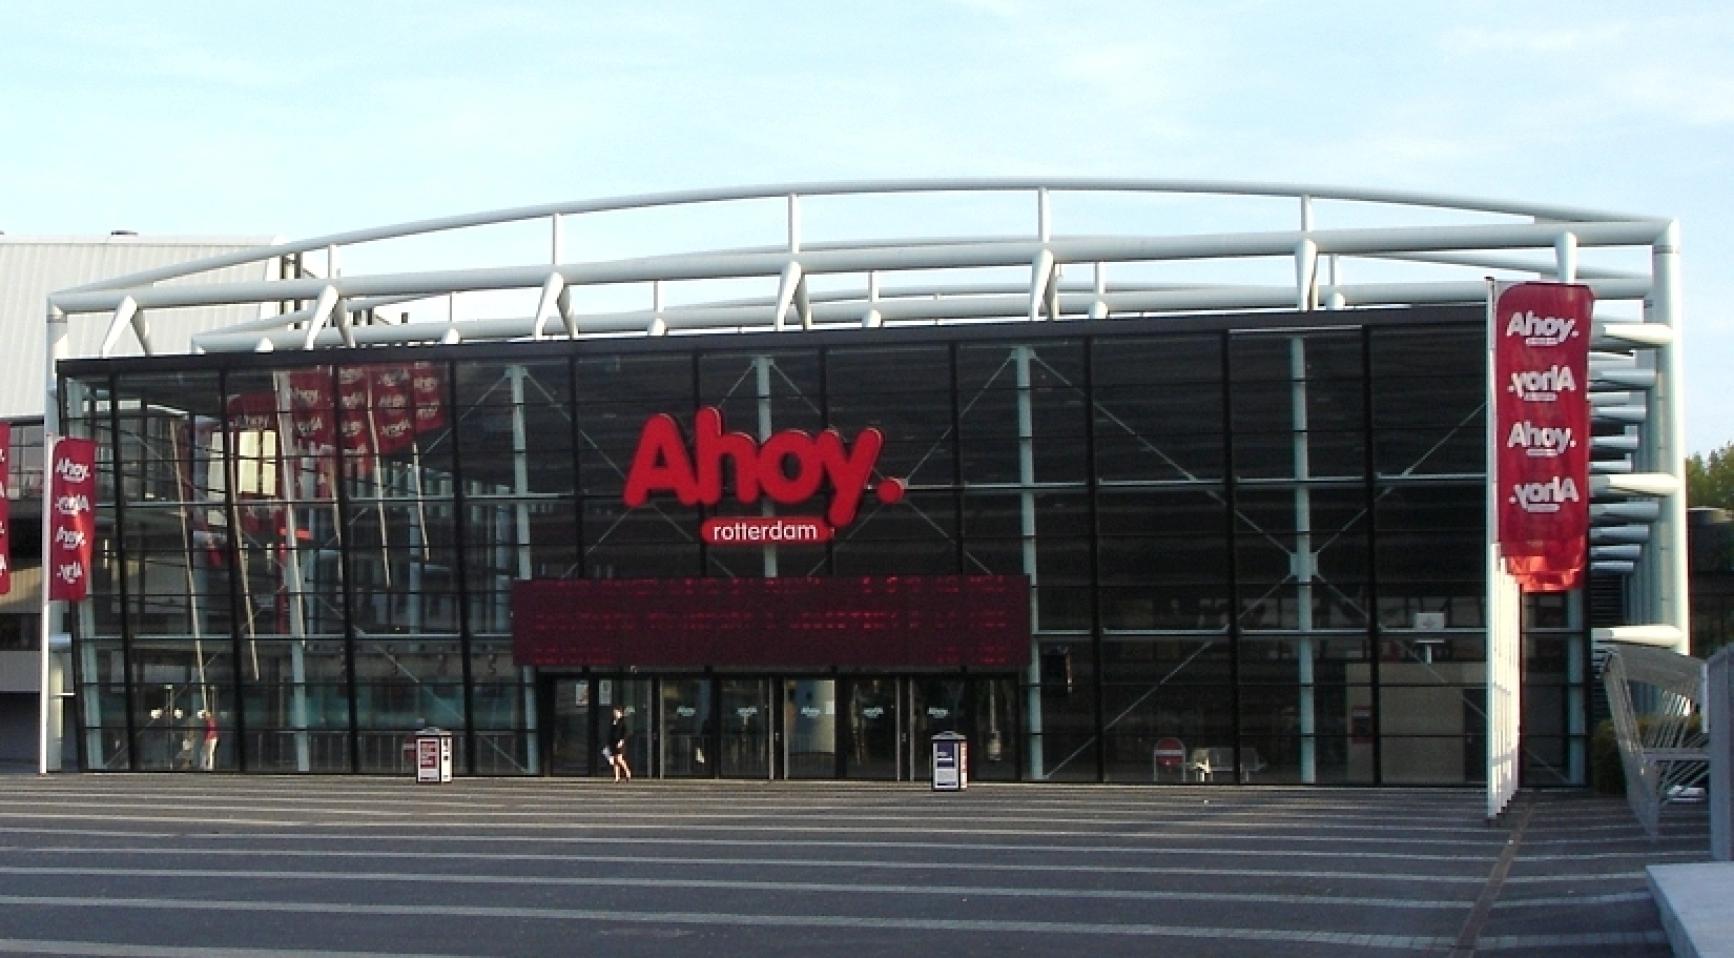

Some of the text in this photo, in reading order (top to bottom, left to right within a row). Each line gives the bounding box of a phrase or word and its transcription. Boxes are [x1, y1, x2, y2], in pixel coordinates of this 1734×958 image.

[1506, 310, 1579, 343] Ahoy.
[1507, 421, 1577, 454] Ahoy.
[623, 406, 907, 527] Ahoy.
[713, 521, 818, 541] rotterdam
